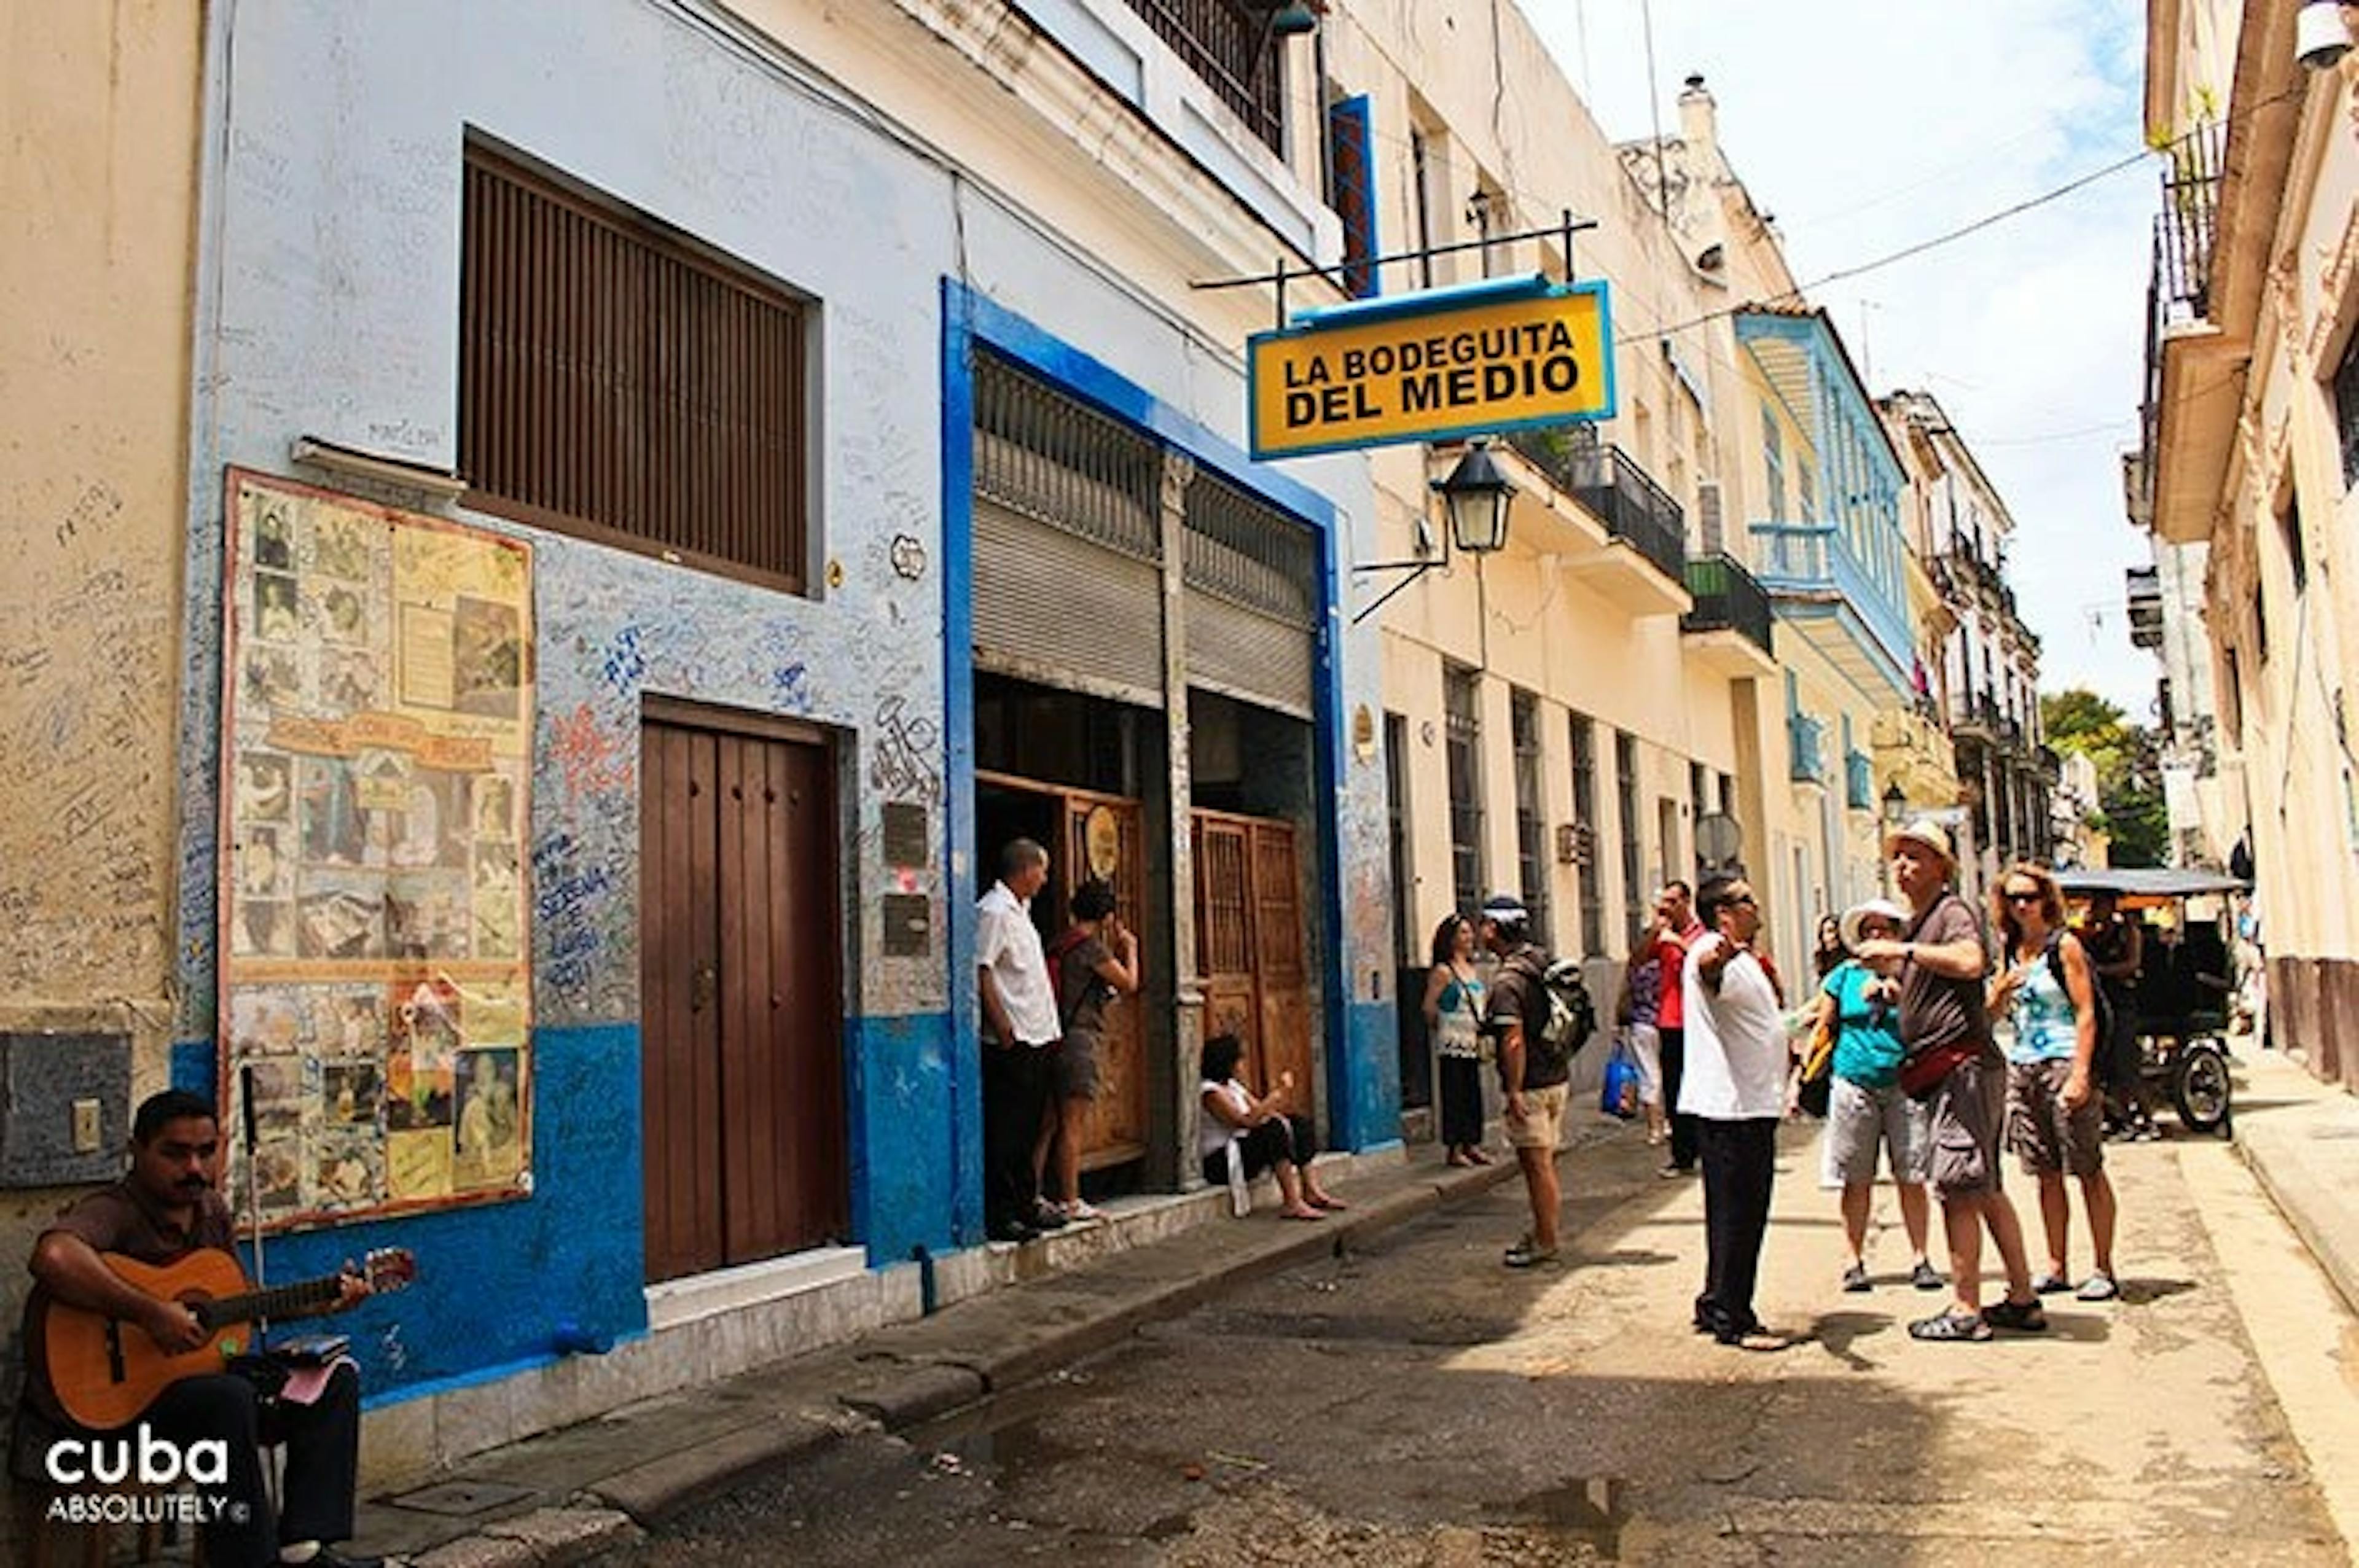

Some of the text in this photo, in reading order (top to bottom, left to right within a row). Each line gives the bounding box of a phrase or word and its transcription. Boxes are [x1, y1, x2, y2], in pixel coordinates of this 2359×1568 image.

[1285, 321, 1573, 389] LA BODEGUITA
[1286, 354, 1579, 429] DEL MEDIO
